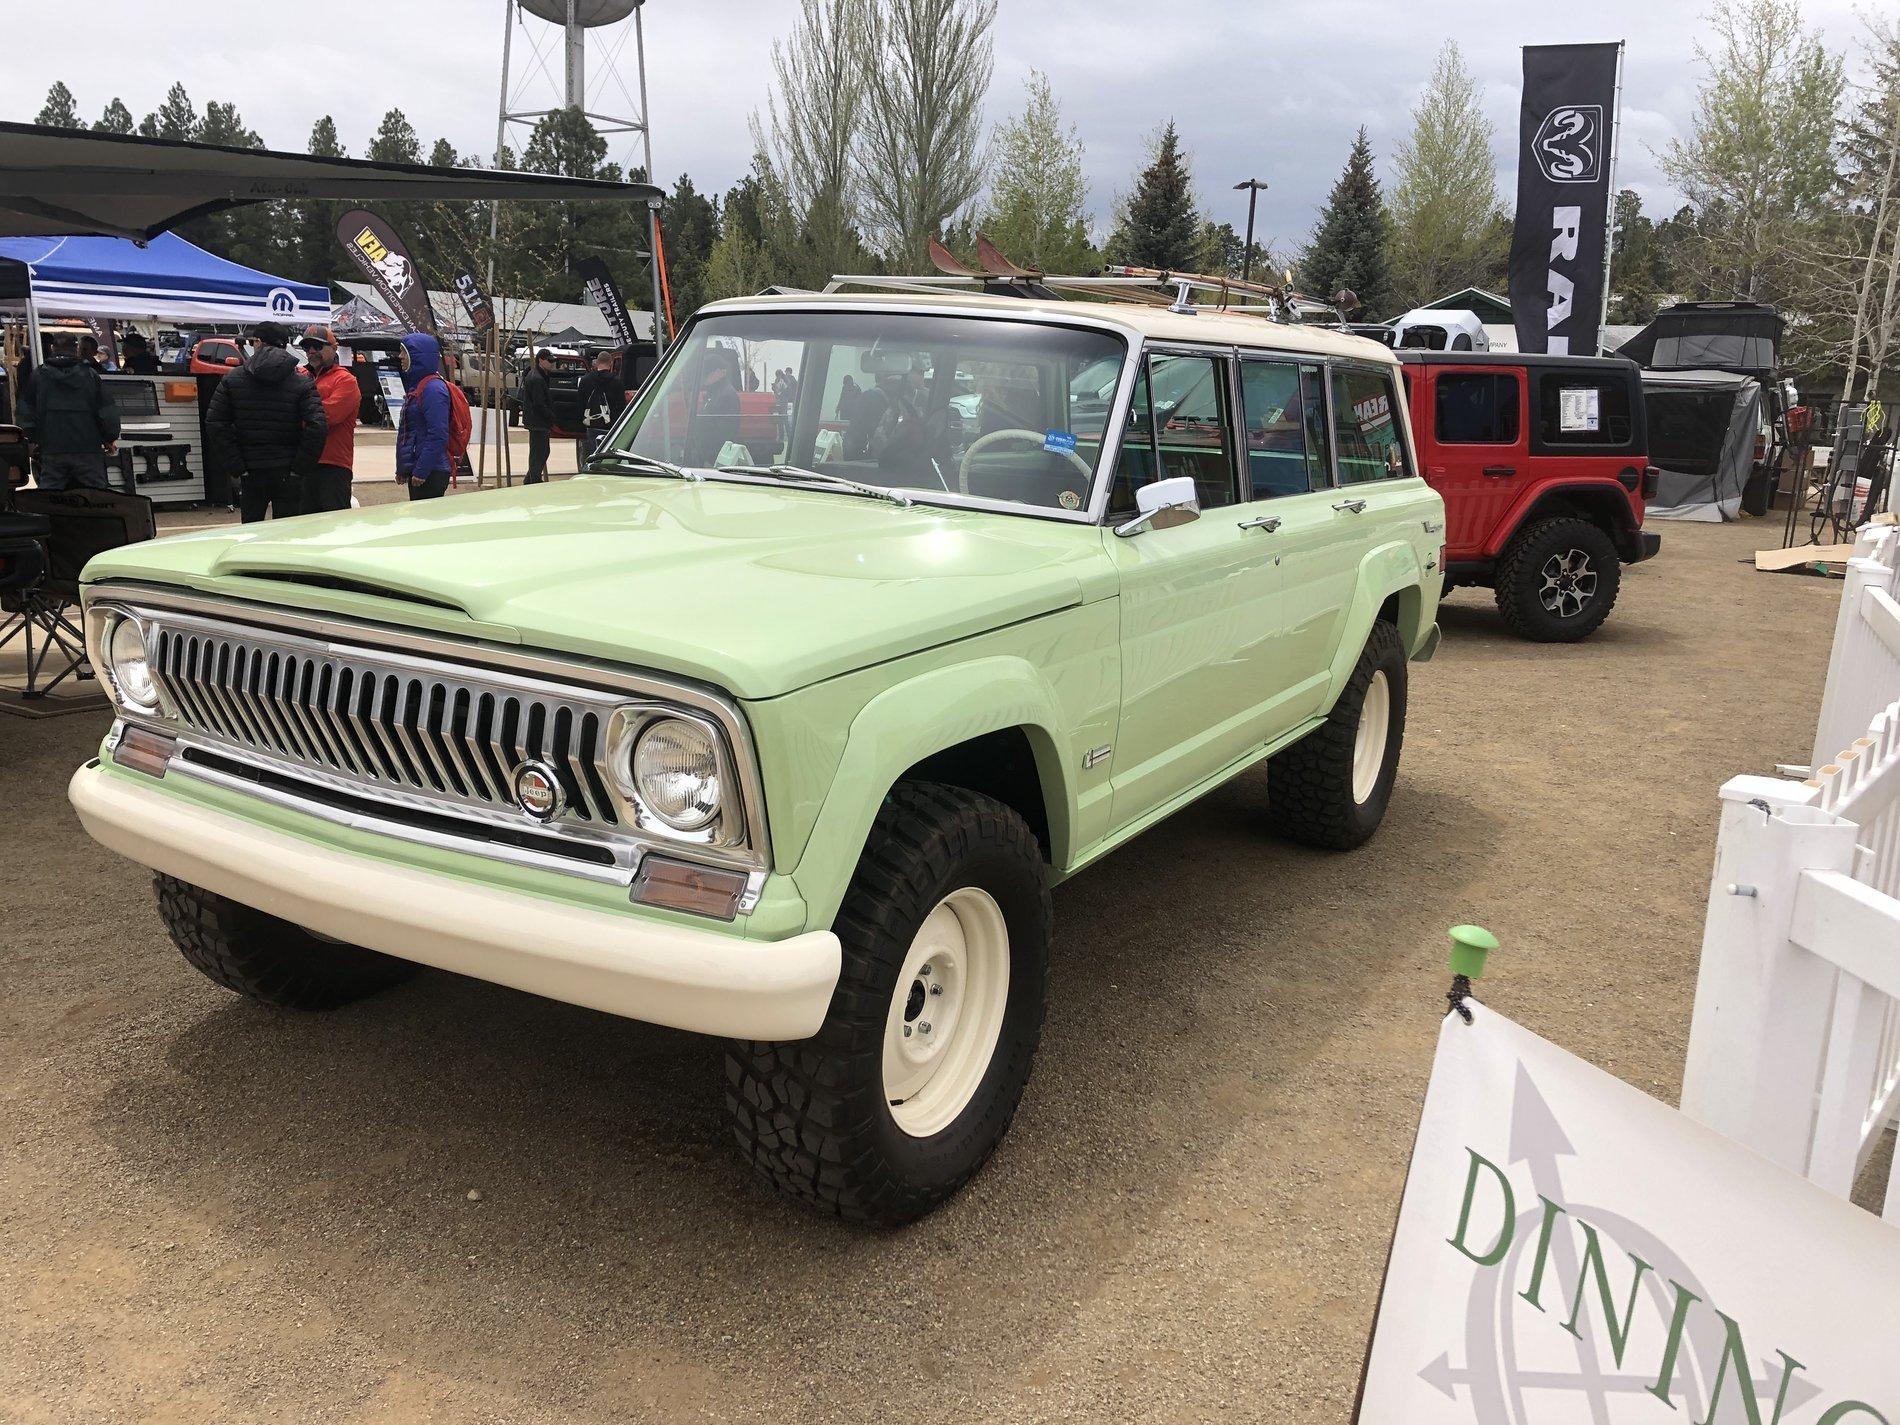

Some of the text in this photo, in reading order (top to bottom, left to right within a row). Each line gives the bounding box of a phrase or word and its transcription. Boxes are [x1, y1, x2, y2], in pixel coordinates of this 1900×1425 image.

[455, 274, 482, 312] 5.11
[603, 283, 621, 315] TRAILERS
[586, 277, 624, 347] ENTURE
[524, 786, 547, 797] Jeep
